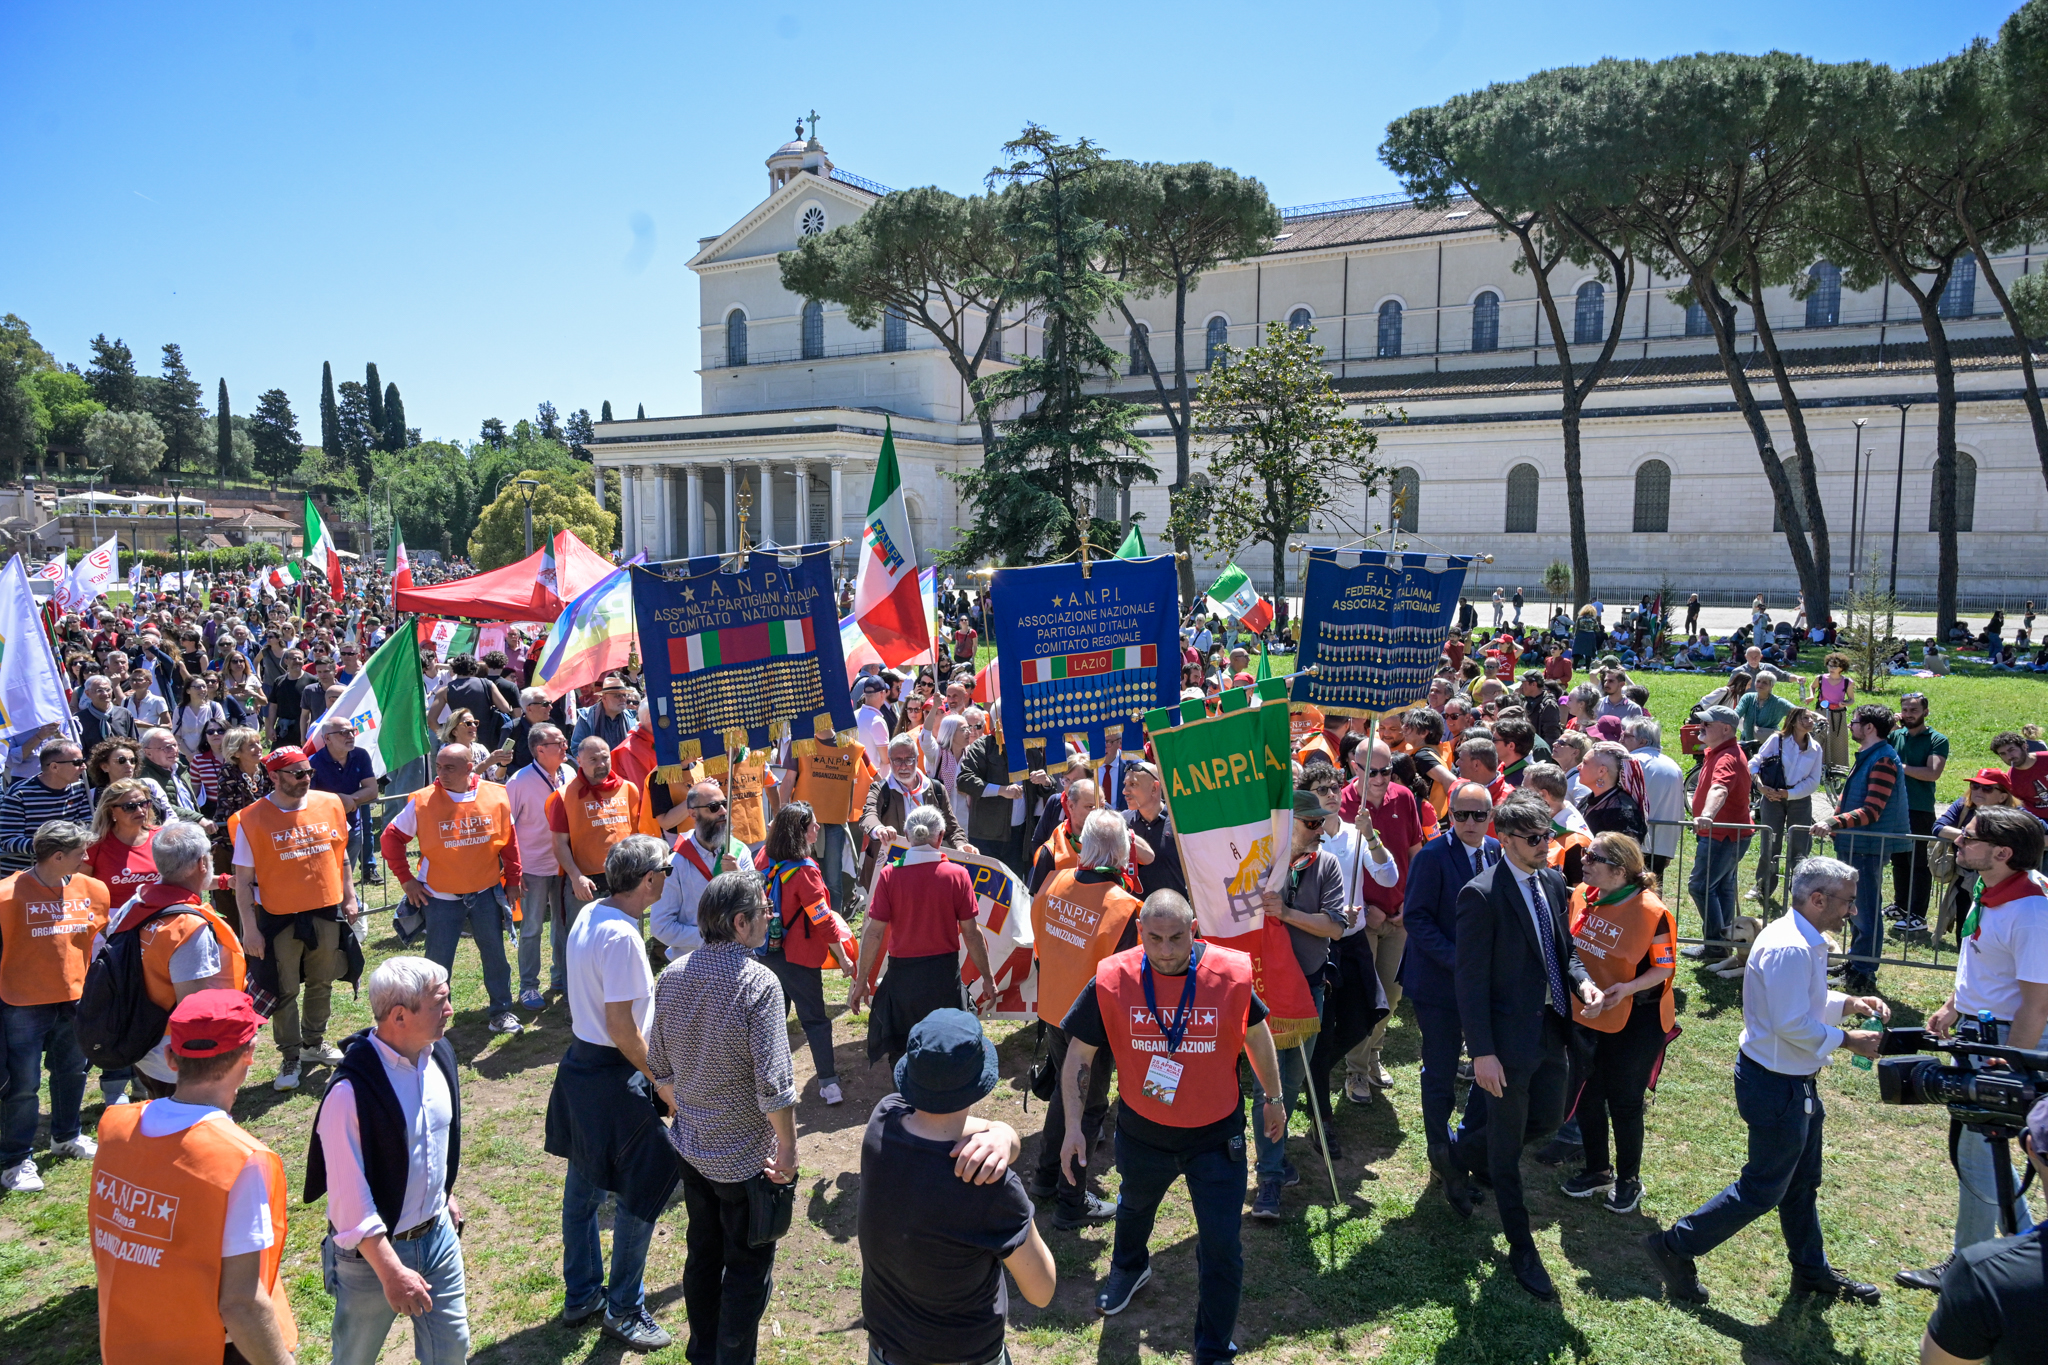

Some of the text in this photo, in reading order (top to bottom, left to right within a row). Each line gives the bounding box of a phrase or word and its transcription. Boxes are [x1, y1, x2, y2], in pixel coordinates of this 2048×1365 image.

[718, 591, 780, 611] PARTIGIANI
[1345, 586, 1394, 600] FEDERAZ.
[1332, 599, 1441, 613] ASSOCIAZ. PARTIGIANE
[669, 601, 810, 634] COMITATO NAZIONALE
[1018, 602, 1155, 628] ASSOCIAZIONE NAZIONALE
[1038, 618, 1138, 639] PARTIGIANI D'ITALIA
[1034, 631, 1141, 654] COMITATO REGIONALE
[1074, 657, 1107, 671] LAZIO
[812, 771, 848, 781] ORGANIZZAZIONE
[1172, 744, 1286, 797] A.N.P.P.I.A.
[450, 816, 485, 831] A.N.P.I.
[285, 825, 322, 840] A.N.P.I.
[280, 843, 331, 860] ORGANIZZAZIONE
[40, 900, 80, 914] A.N.P.I.
[1054, 900, 1088, 923] A.N.P.I.
[1059, 914, 1076, 927] Roma
[32, 924, 88, 937] ORGANIZZAZIONE
[1045, 922, 1086, 949] ORGANIZZAZIONE
[1581, 926, 1596, 937] Roma
[1131, 1039, 1216, 1053] ORGANIZAZIONE
[104, 1180, 156, 1218] A.N.P.I.
[112, 1207, 136, 1228] Roma
